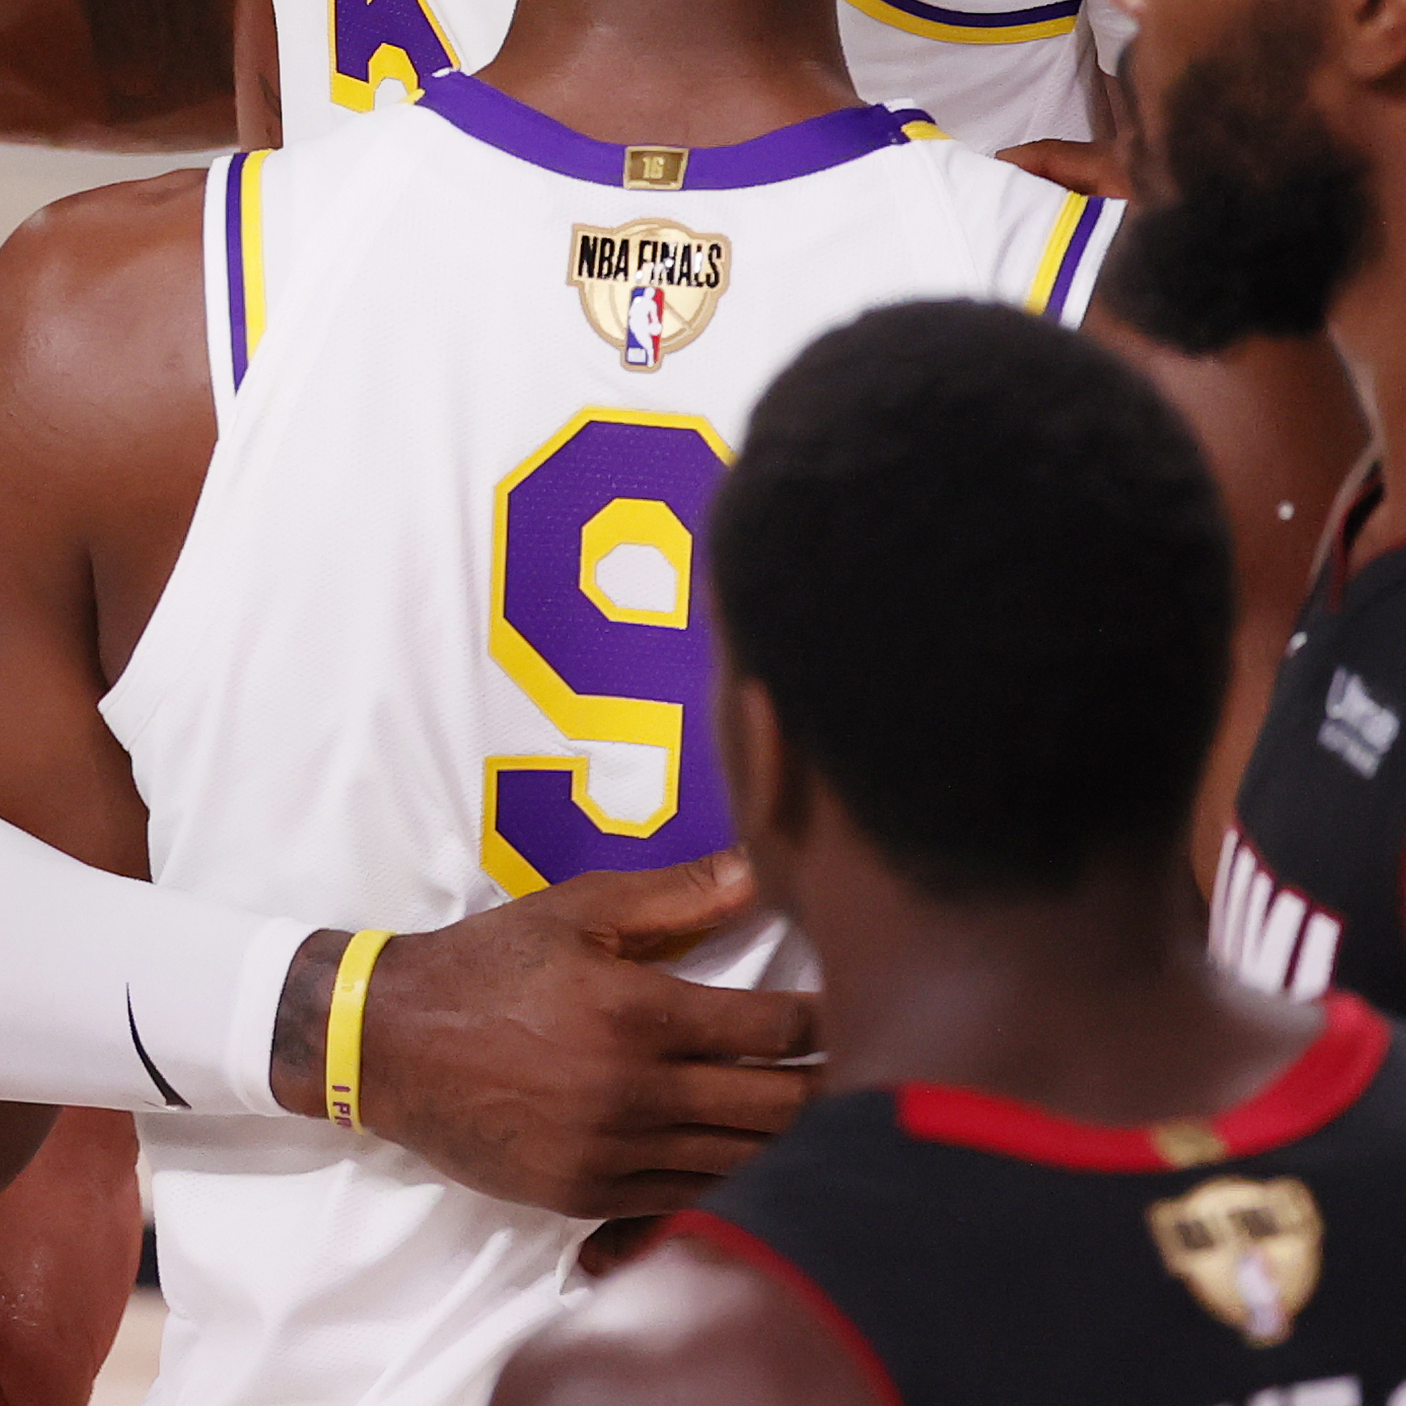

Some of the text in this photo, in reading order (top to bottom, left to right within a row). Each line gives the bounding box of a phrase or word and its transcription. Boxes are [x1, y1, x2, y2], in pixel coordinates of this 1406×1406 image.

[577, 234, 723, 289] NBA FINALS
[481, 405, 736, 906] 9
